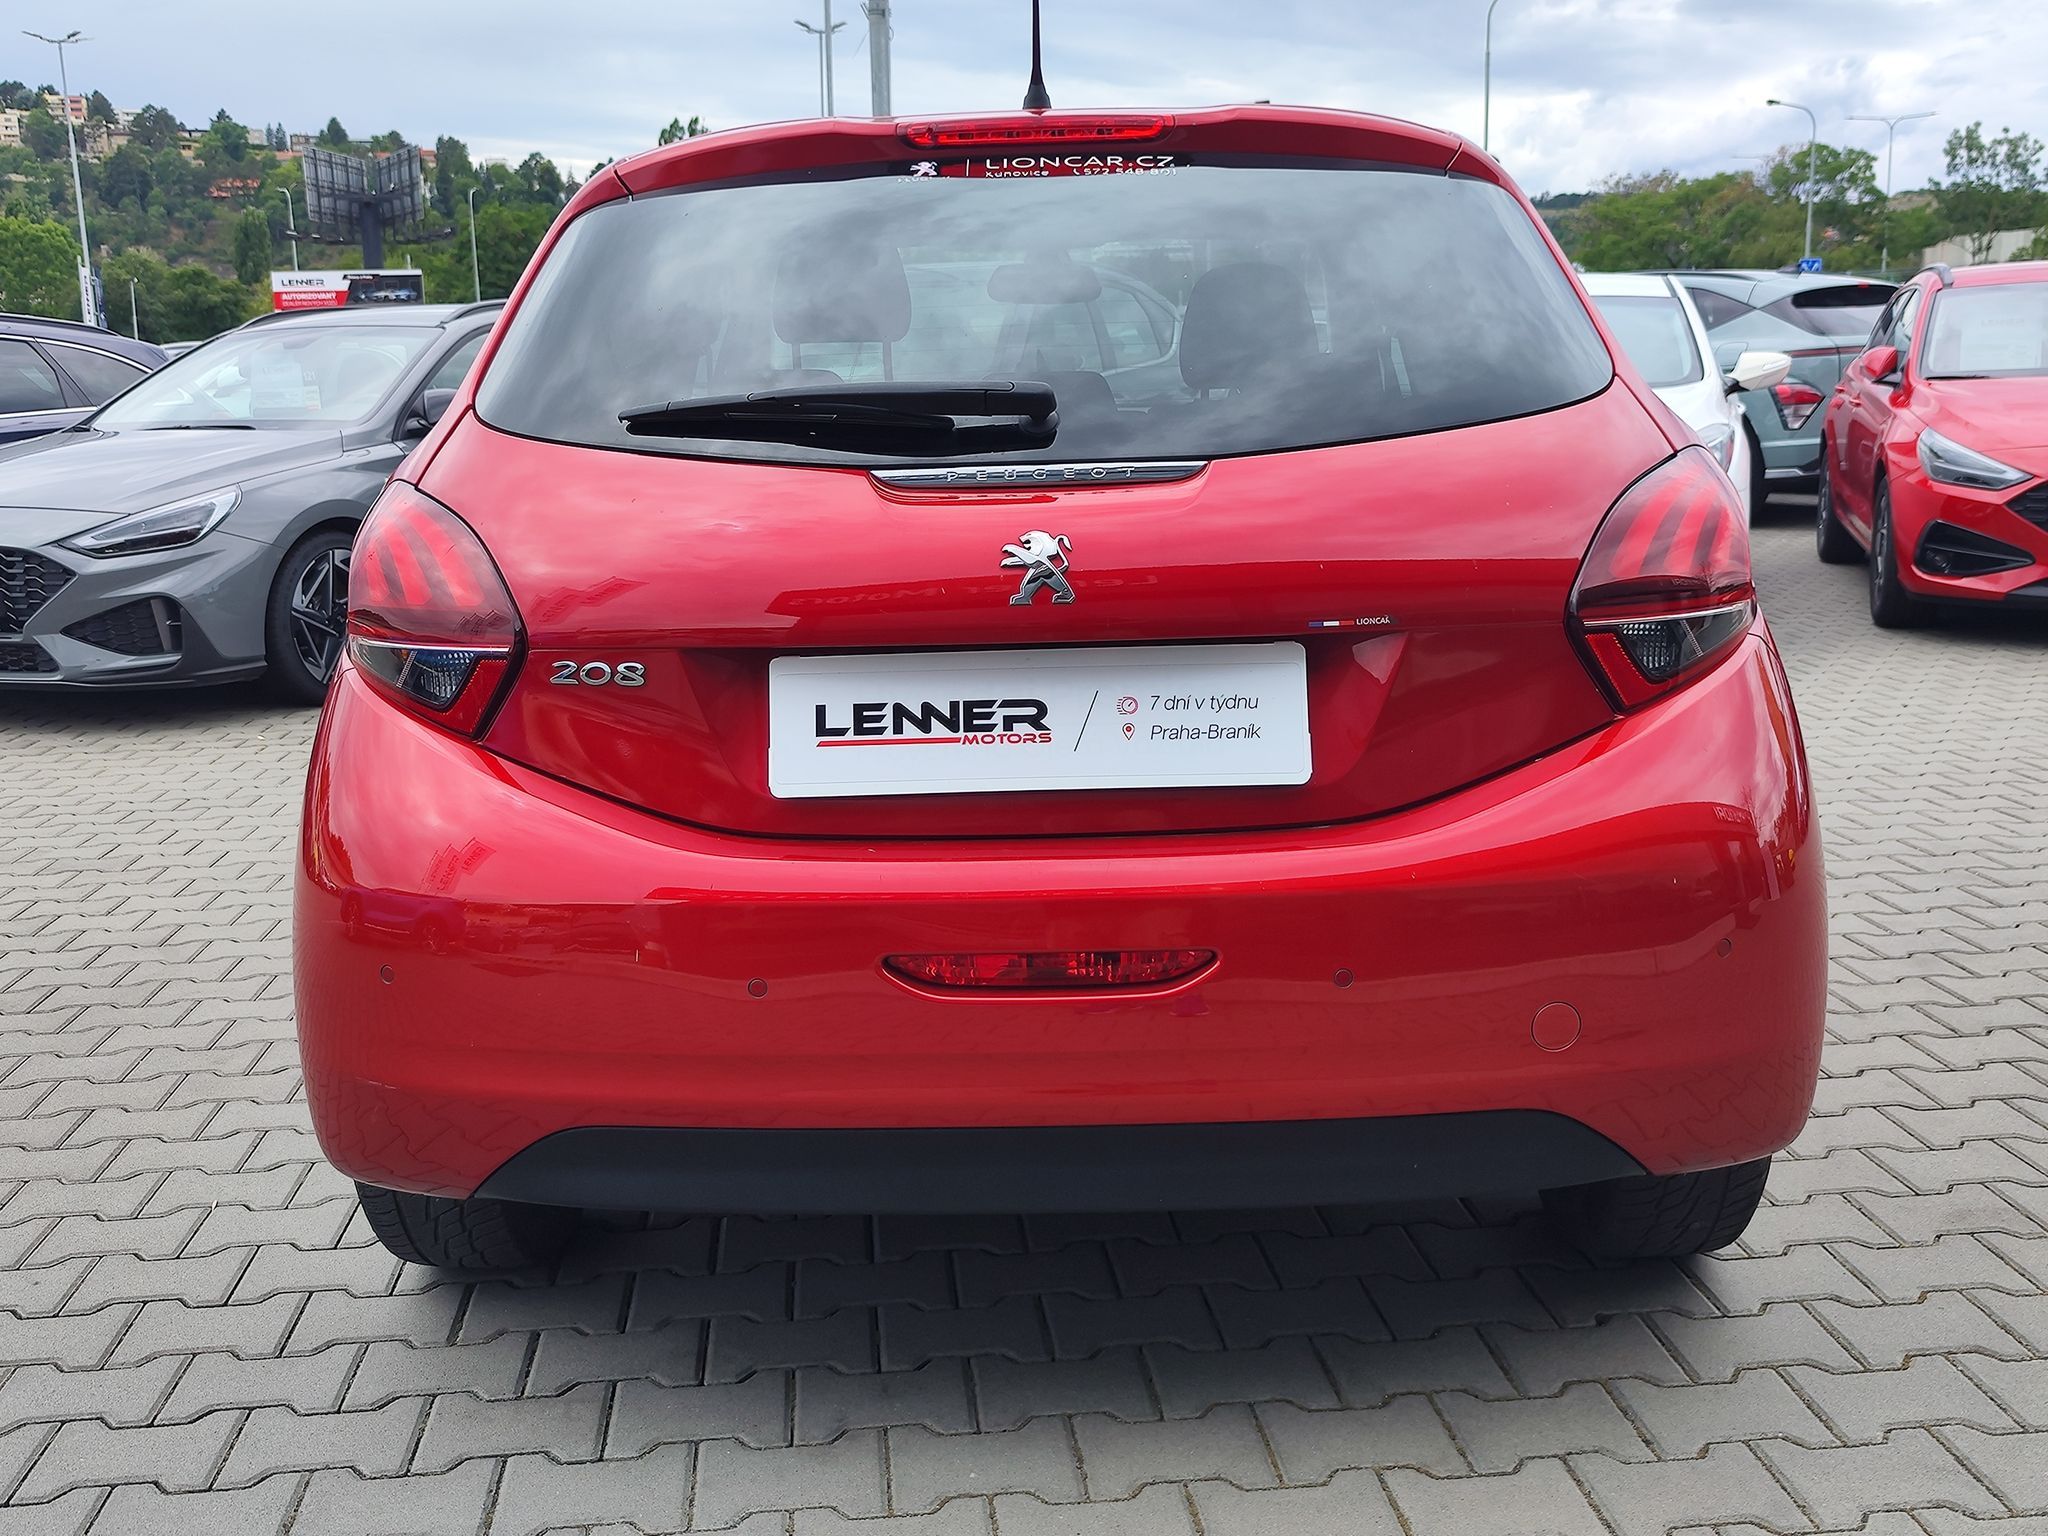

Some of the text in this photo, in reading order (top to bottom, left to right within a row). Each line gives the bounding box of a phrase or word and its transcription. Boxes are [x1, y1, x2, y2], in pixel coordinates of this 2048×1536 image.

[985, 156, 1174, 169] LIONCAR.CZ
[946, 466, 1135, 482] PEUGEOT
[1356, 616, 1390, 625] LIONCAR
[549, 660, 646, 686] 208
[1150, 694, 1259, 713] 7 dní v týdnu
[815, 698, 1052, 737] LENNER
[960, 732, 1052, 745] MOTORS
[1150, 723, 1261, 740] Praha-Braník
